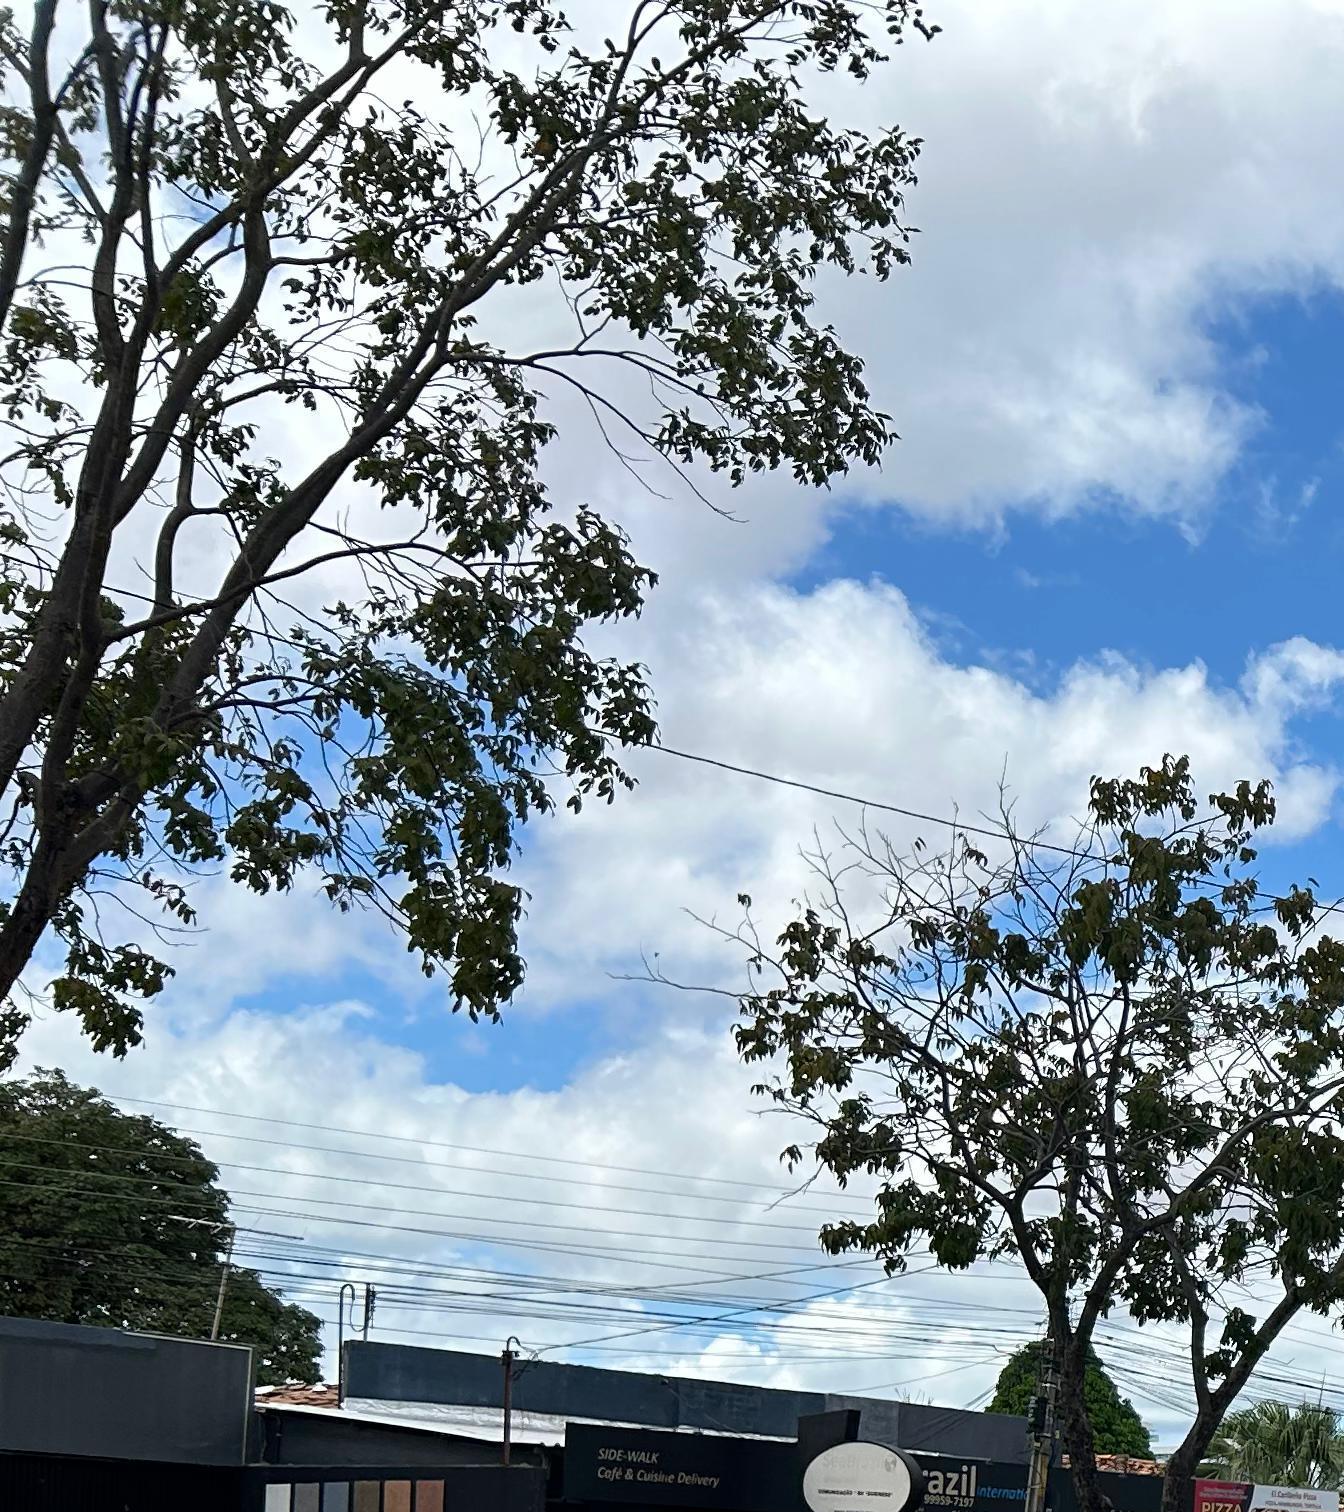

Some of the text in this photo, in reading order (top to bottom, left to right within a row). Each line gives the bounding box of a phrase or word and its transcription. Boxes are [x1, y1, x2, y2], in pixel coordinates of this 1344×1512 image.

[598, 1448, 659, 1464] SIDE-WALK
[598, 1466, 720, 1488] Café & Cuisine Delivery
